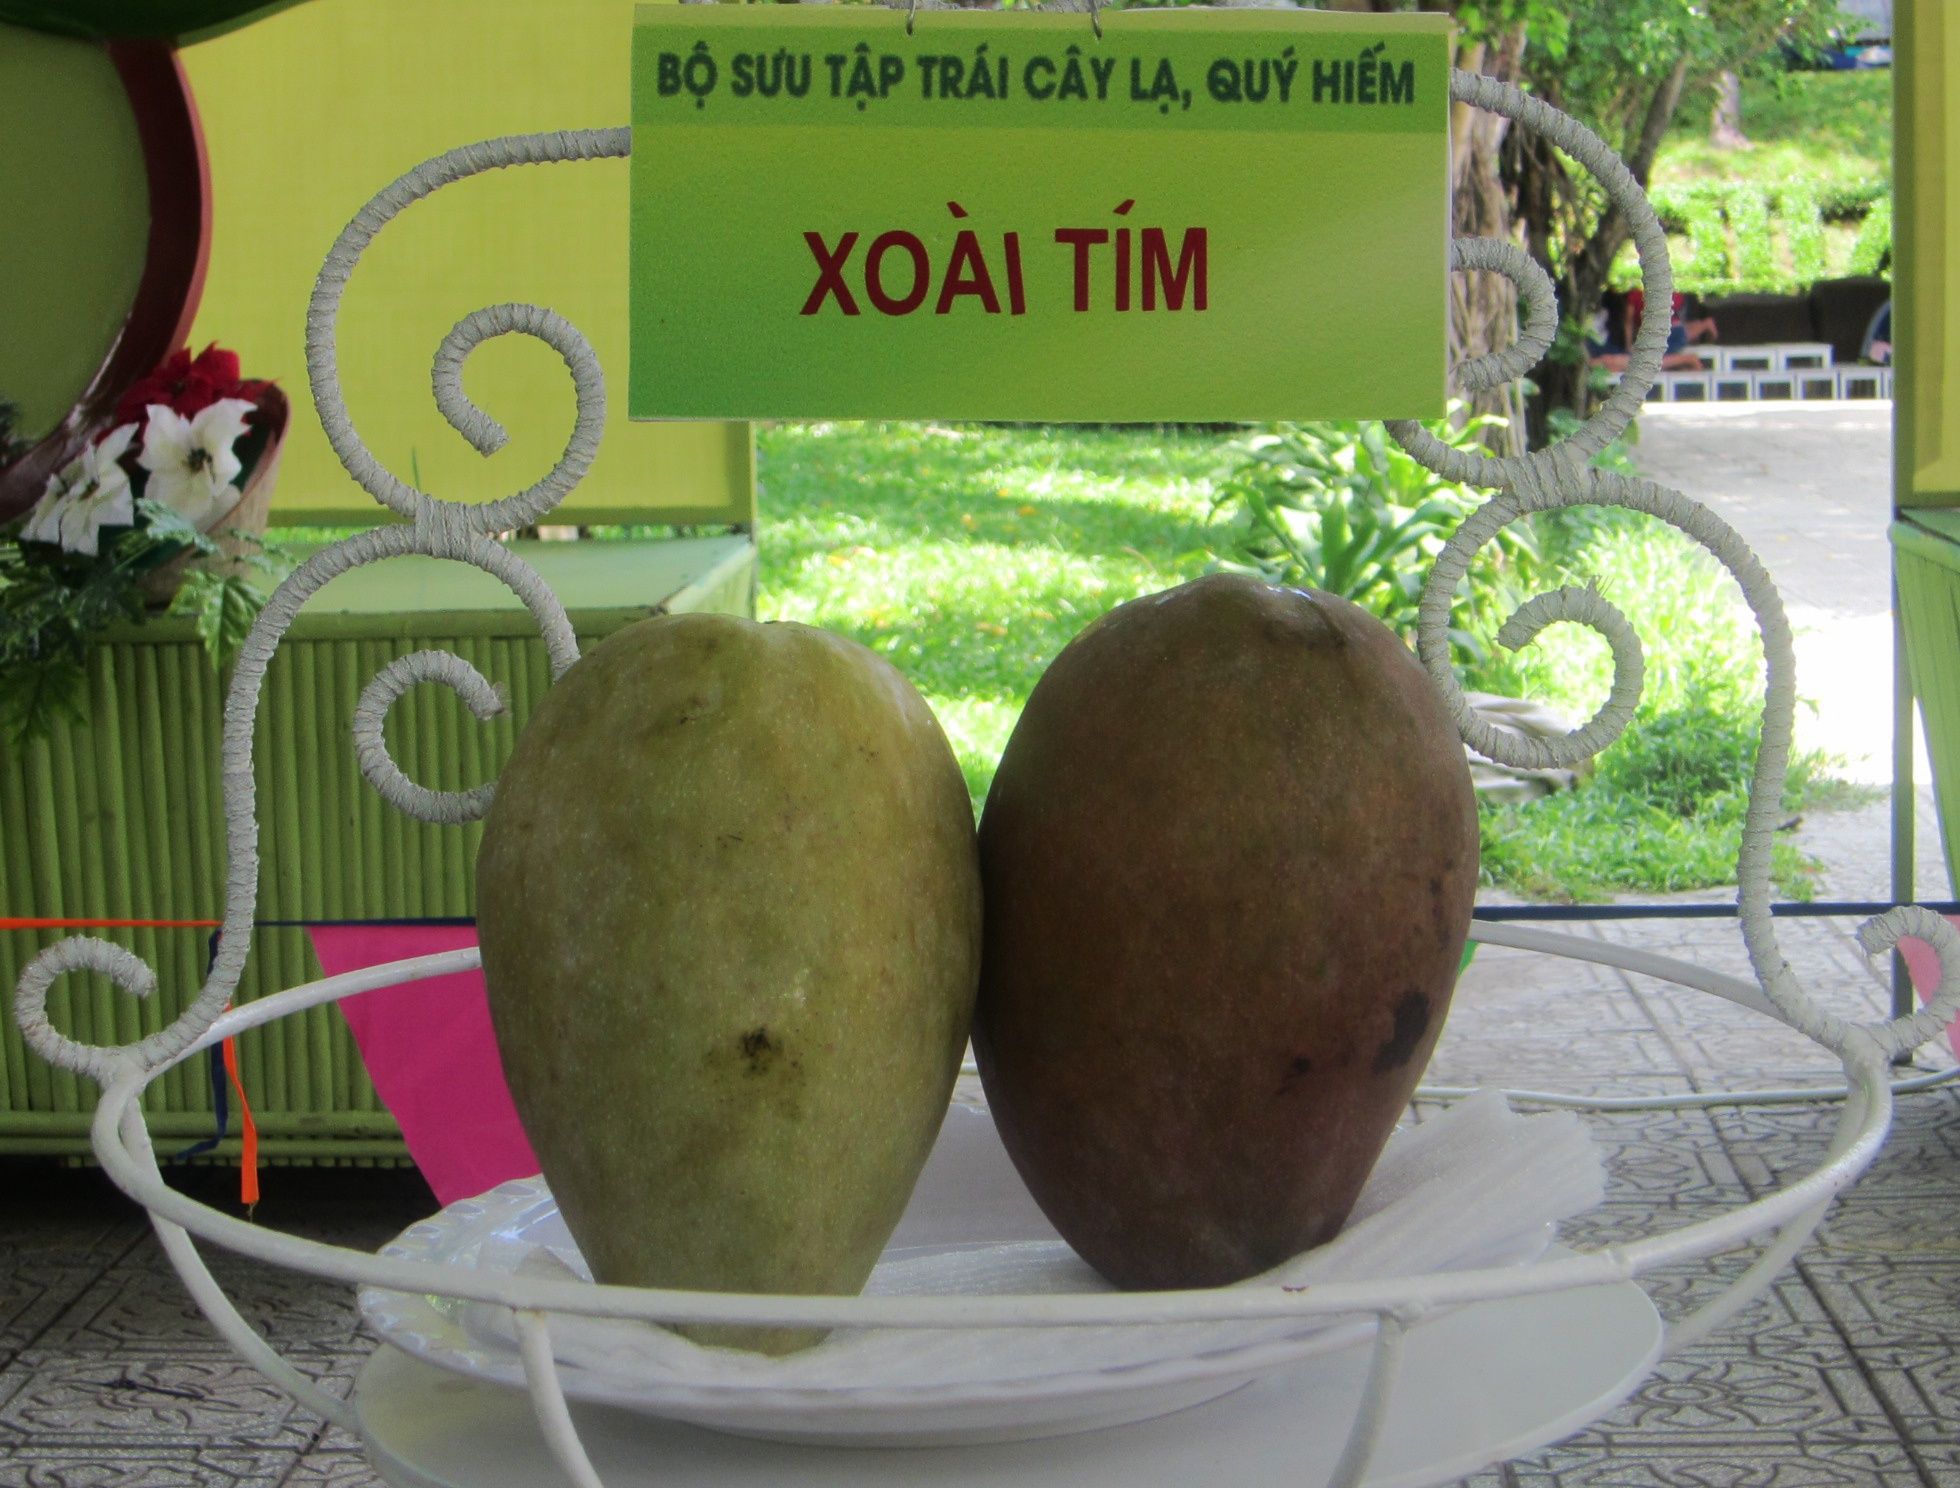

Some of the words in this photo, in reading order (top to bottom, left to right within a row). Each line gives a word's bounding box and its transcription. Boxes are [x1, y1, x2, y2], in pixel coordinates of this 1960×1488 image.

[656, 39, 719, 111] BỘ
[730, 45, 812, 100] SƯU
[823, 40, 906, 113] TẬP
[915, 40, 1010, 102] TRÁI
[1022, 43, 1117, 104] CÂY
[1128, 56, 1193, 116] LẠ,
[1205, 44, 1299, 106] QUÝ
[1311, 40, 1416, 107] HIẾM
[799, 200, 1027, 317] XOÀI
[1054, 198, 1209, 313] TÍM
